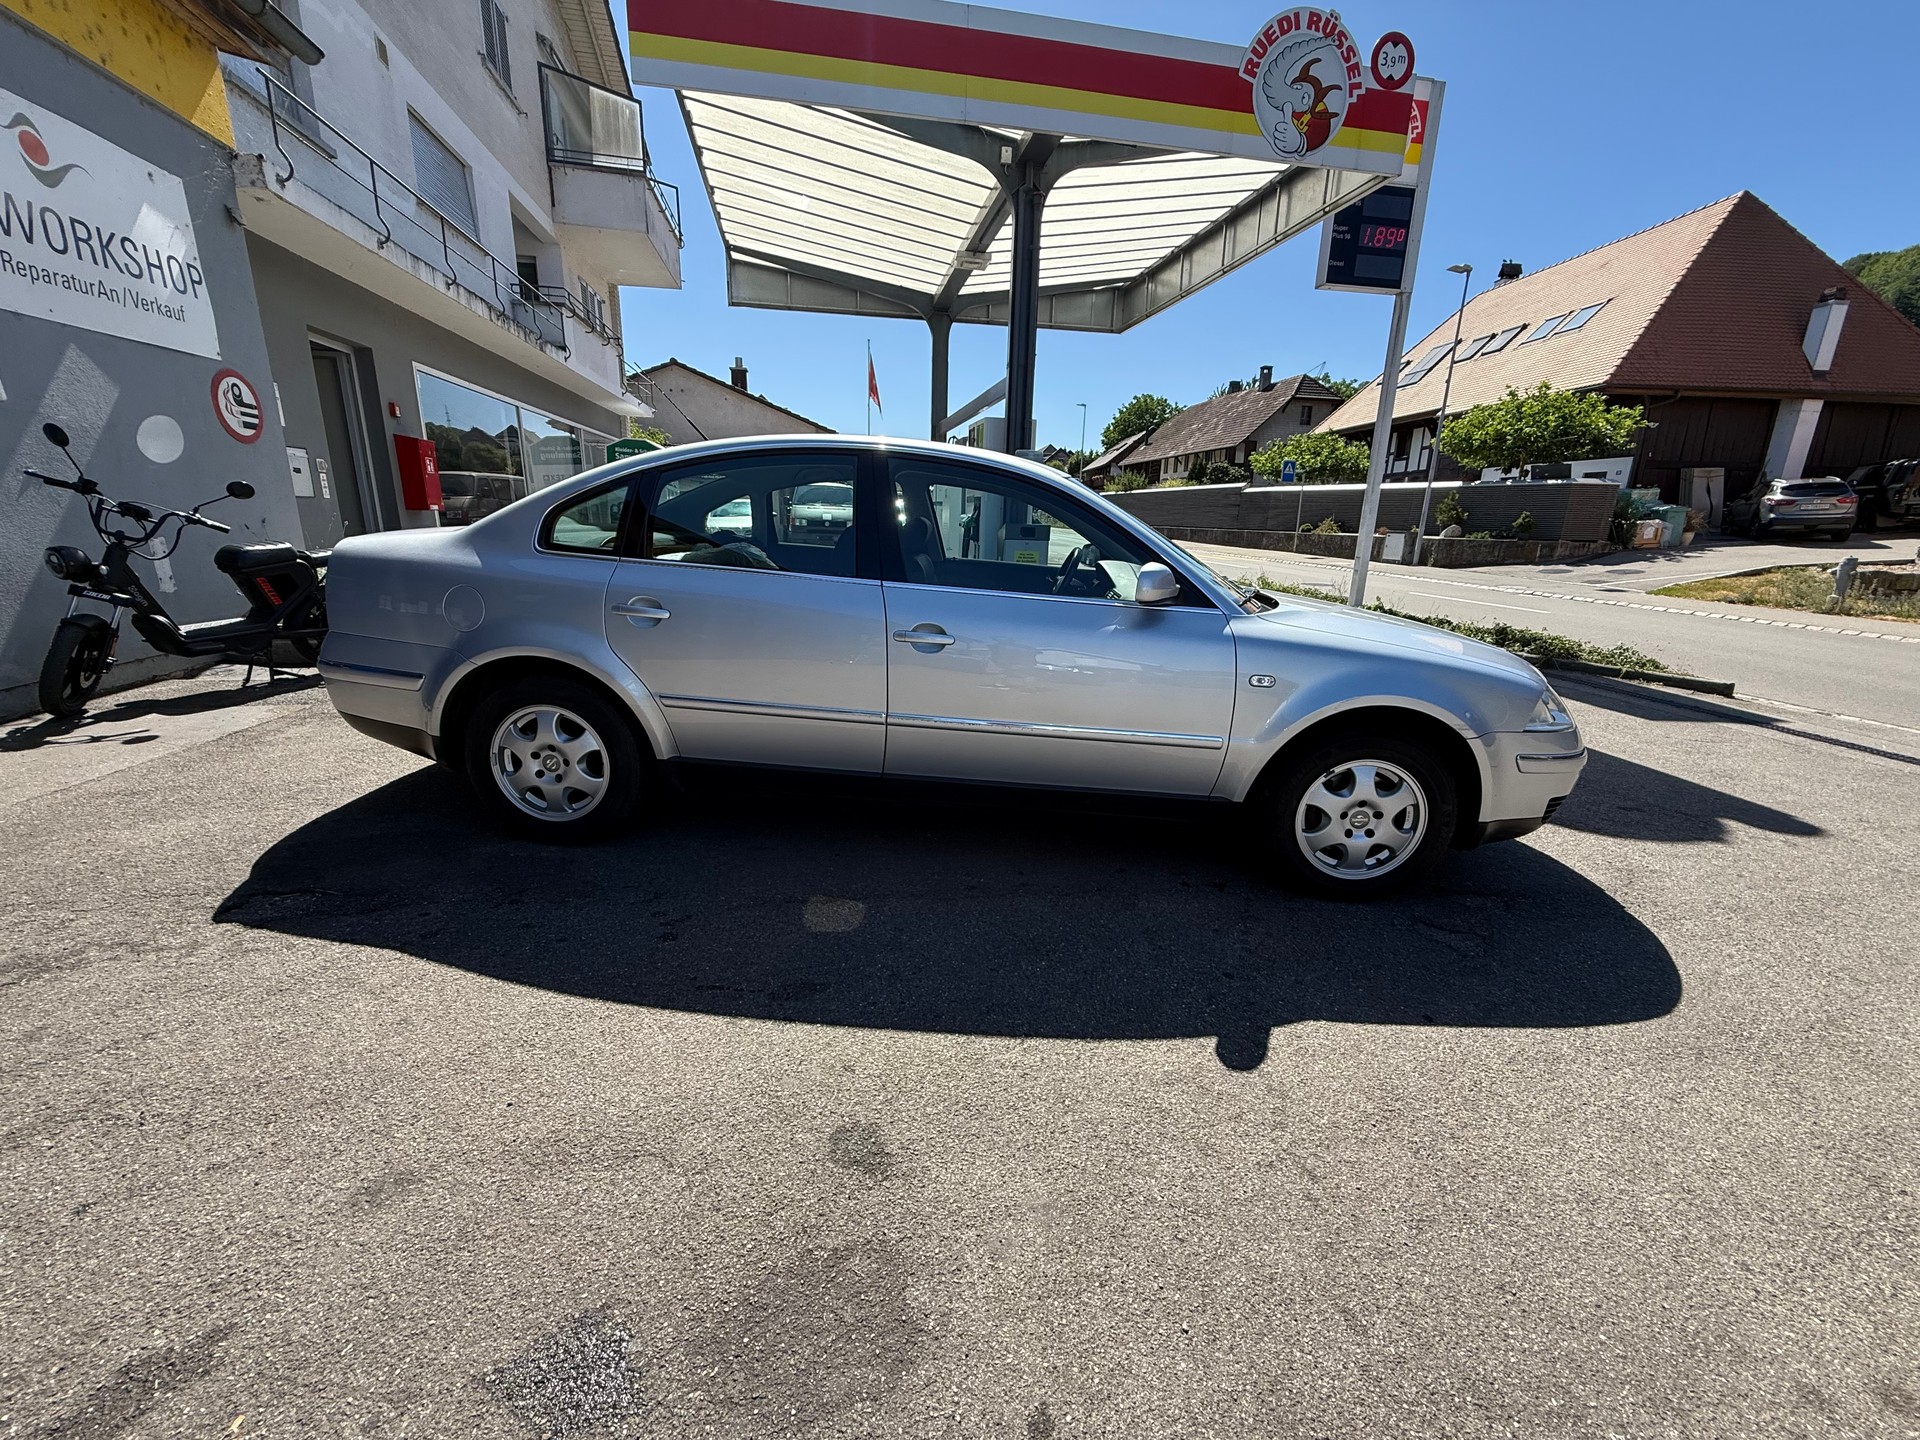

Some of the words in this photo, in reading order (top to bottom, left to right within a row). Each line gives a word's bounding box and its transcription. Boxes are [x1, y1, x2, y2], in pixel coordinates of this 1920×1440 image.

[1242, 11, 1301, 79] RUEDI
[1306, 10, 1363, 98] RÜSSEL
[0, 191, 203, 299] WORKSHOP
[1333, 223, 1349, 231] Super
[1328, 259, 1345, 267] Diesel
